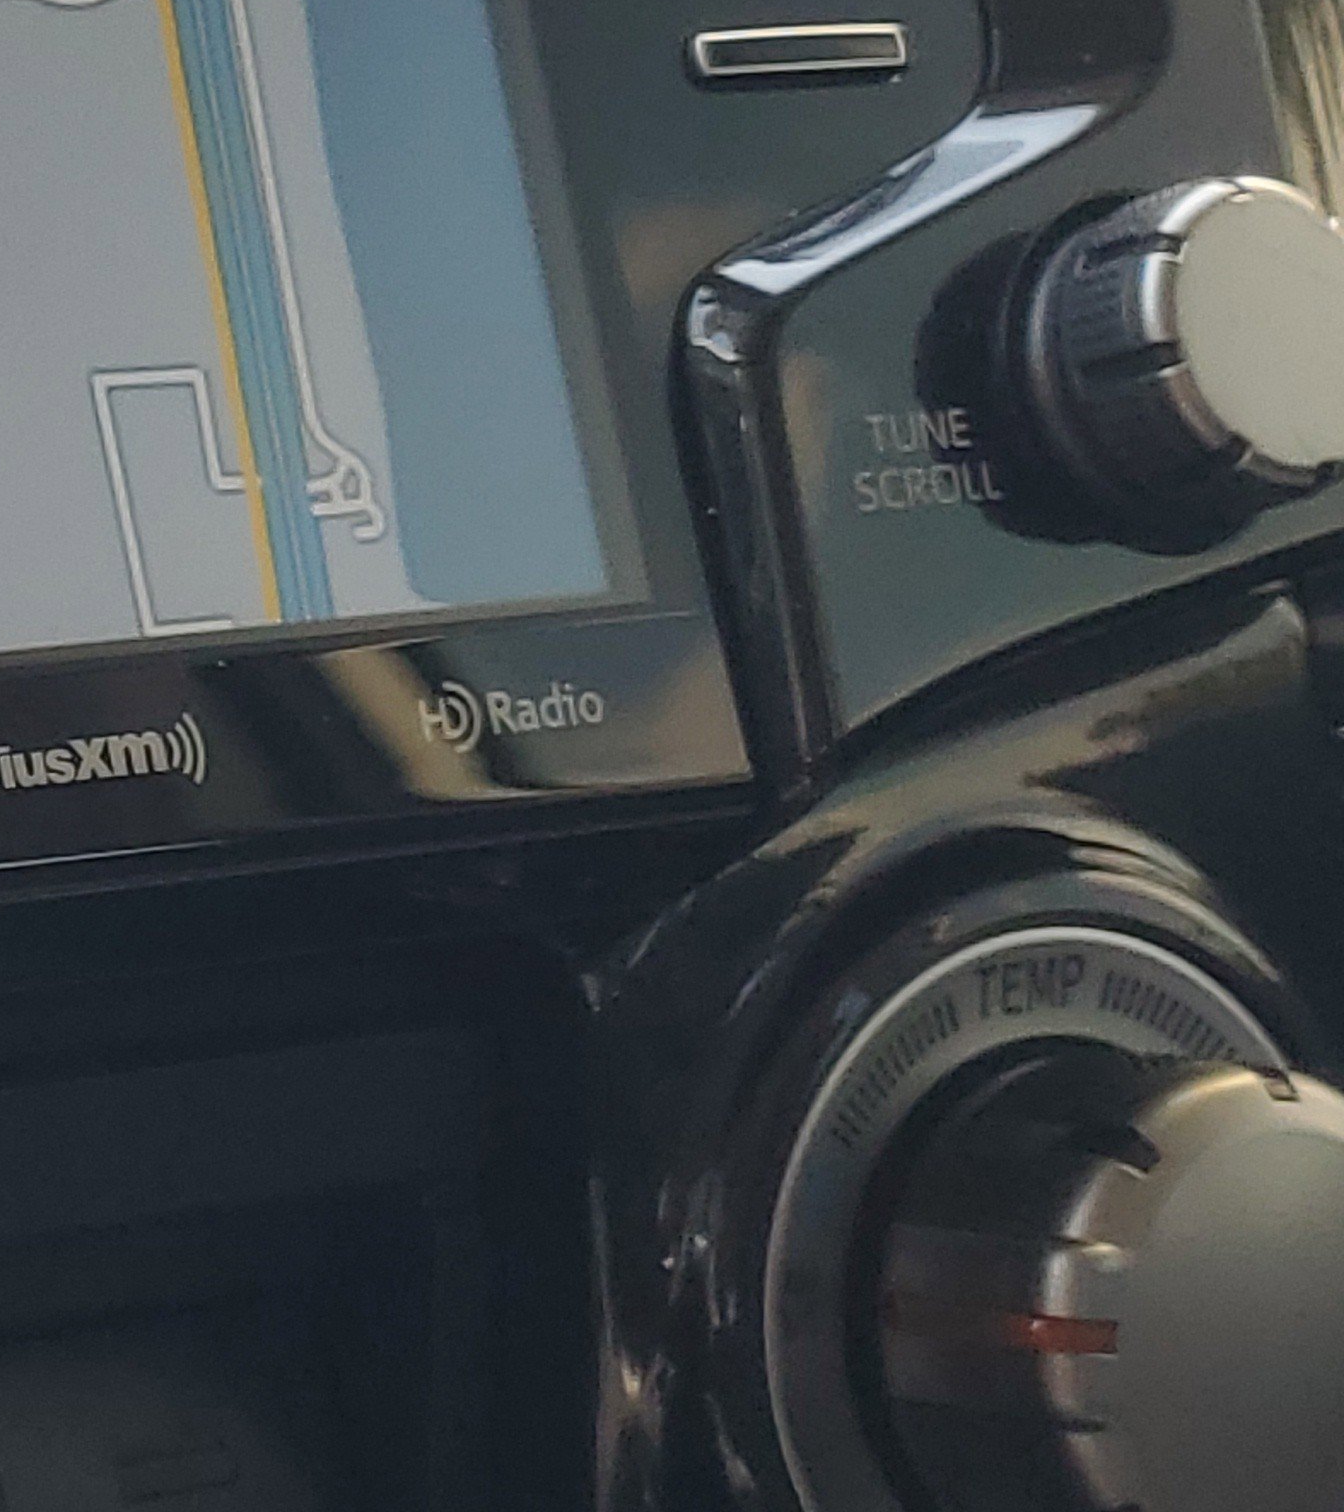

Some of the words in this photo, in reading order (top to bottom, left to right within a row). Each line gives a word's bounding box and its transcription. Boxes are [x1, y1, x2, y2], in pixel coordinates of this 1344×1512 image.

[863, 406, 975, 454] TUNE
[851, 461, 1005, 514] SCROLL
[486, 684, 606, 738] Radio
[973, 952, 1087, 1018] TEMP
